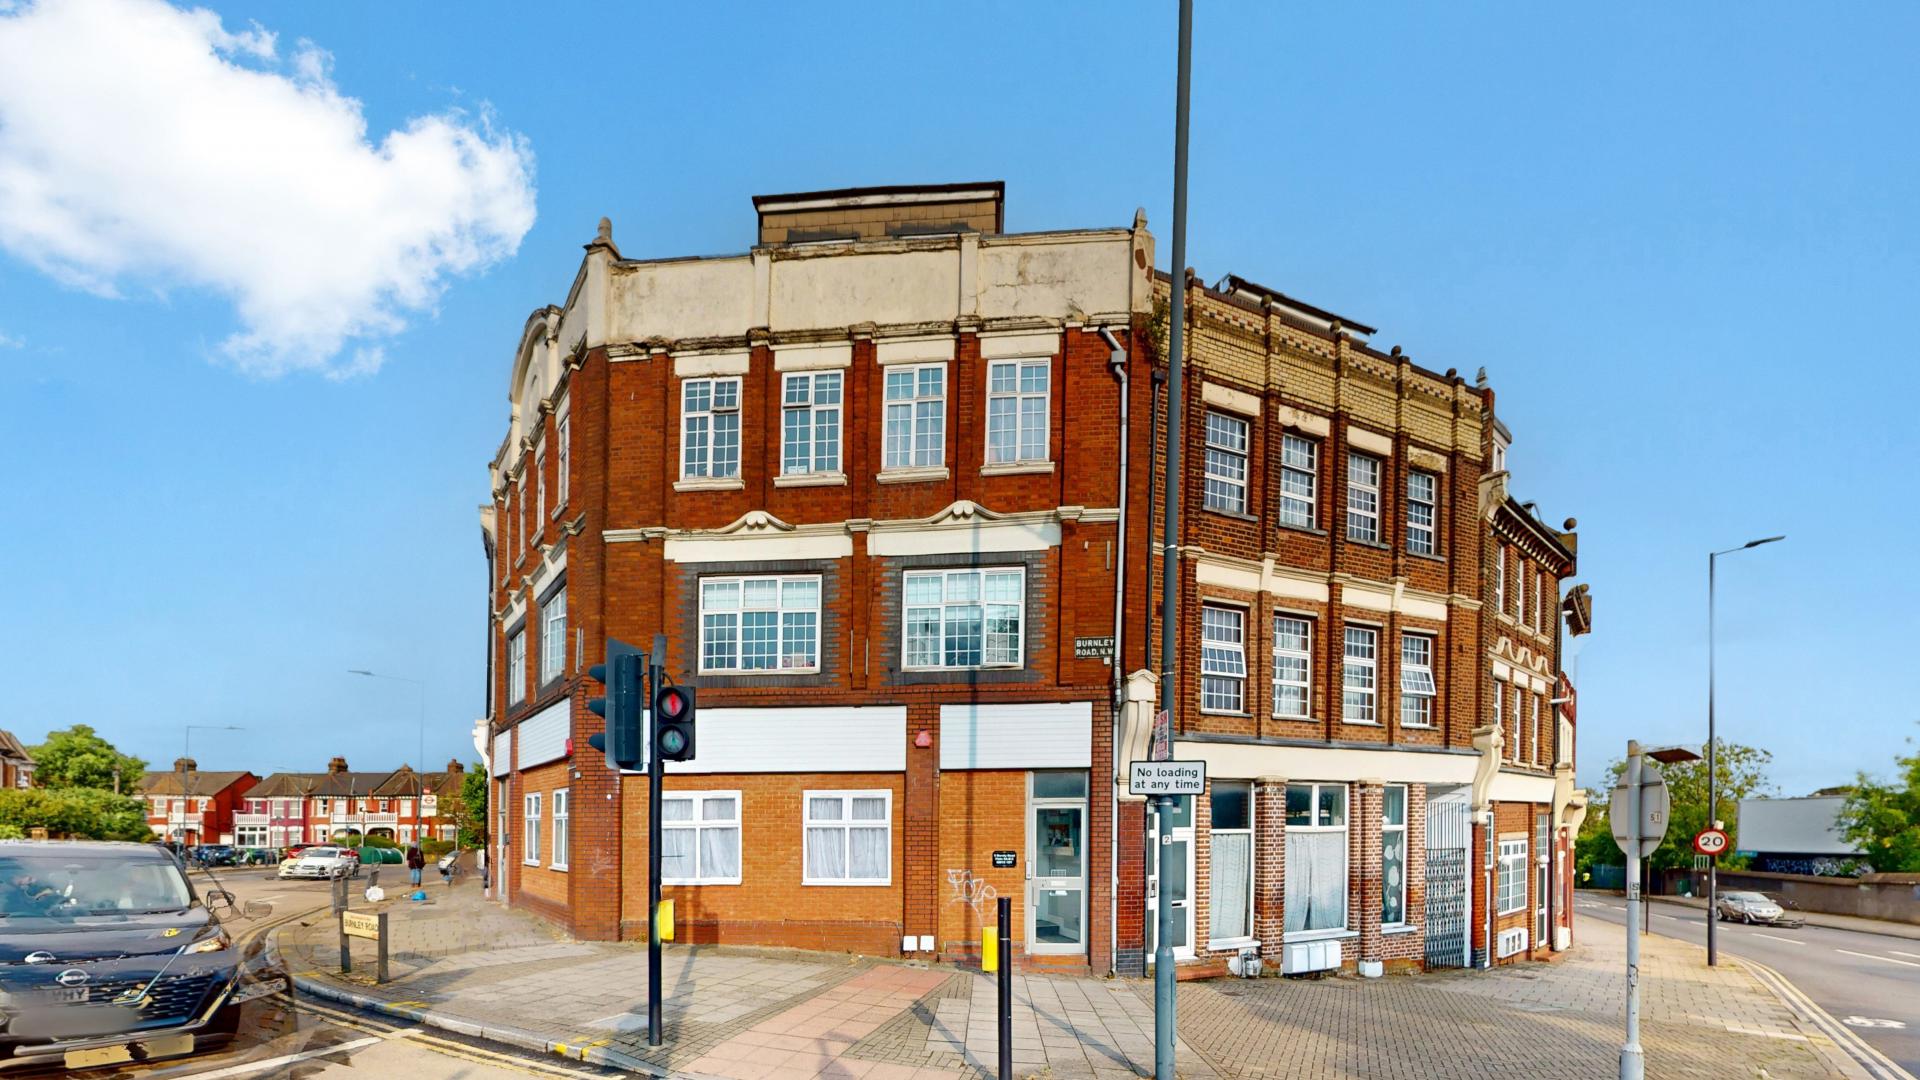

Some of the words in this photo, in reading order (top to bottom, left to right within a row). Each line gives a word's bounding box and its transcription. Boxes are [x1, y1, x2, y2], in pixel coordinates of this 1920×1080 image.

[1076, 639, 1114, 647] BURNLEY
[1137, 768, 1152, 777] No
[1157, 767, 1198, 778] loading
[1134, 780, 1146, 789] at
[1151, 781, 1170, 790] any
[1175, 780, 1200, 789] time
[1700, 836, 1724, 846] 20
